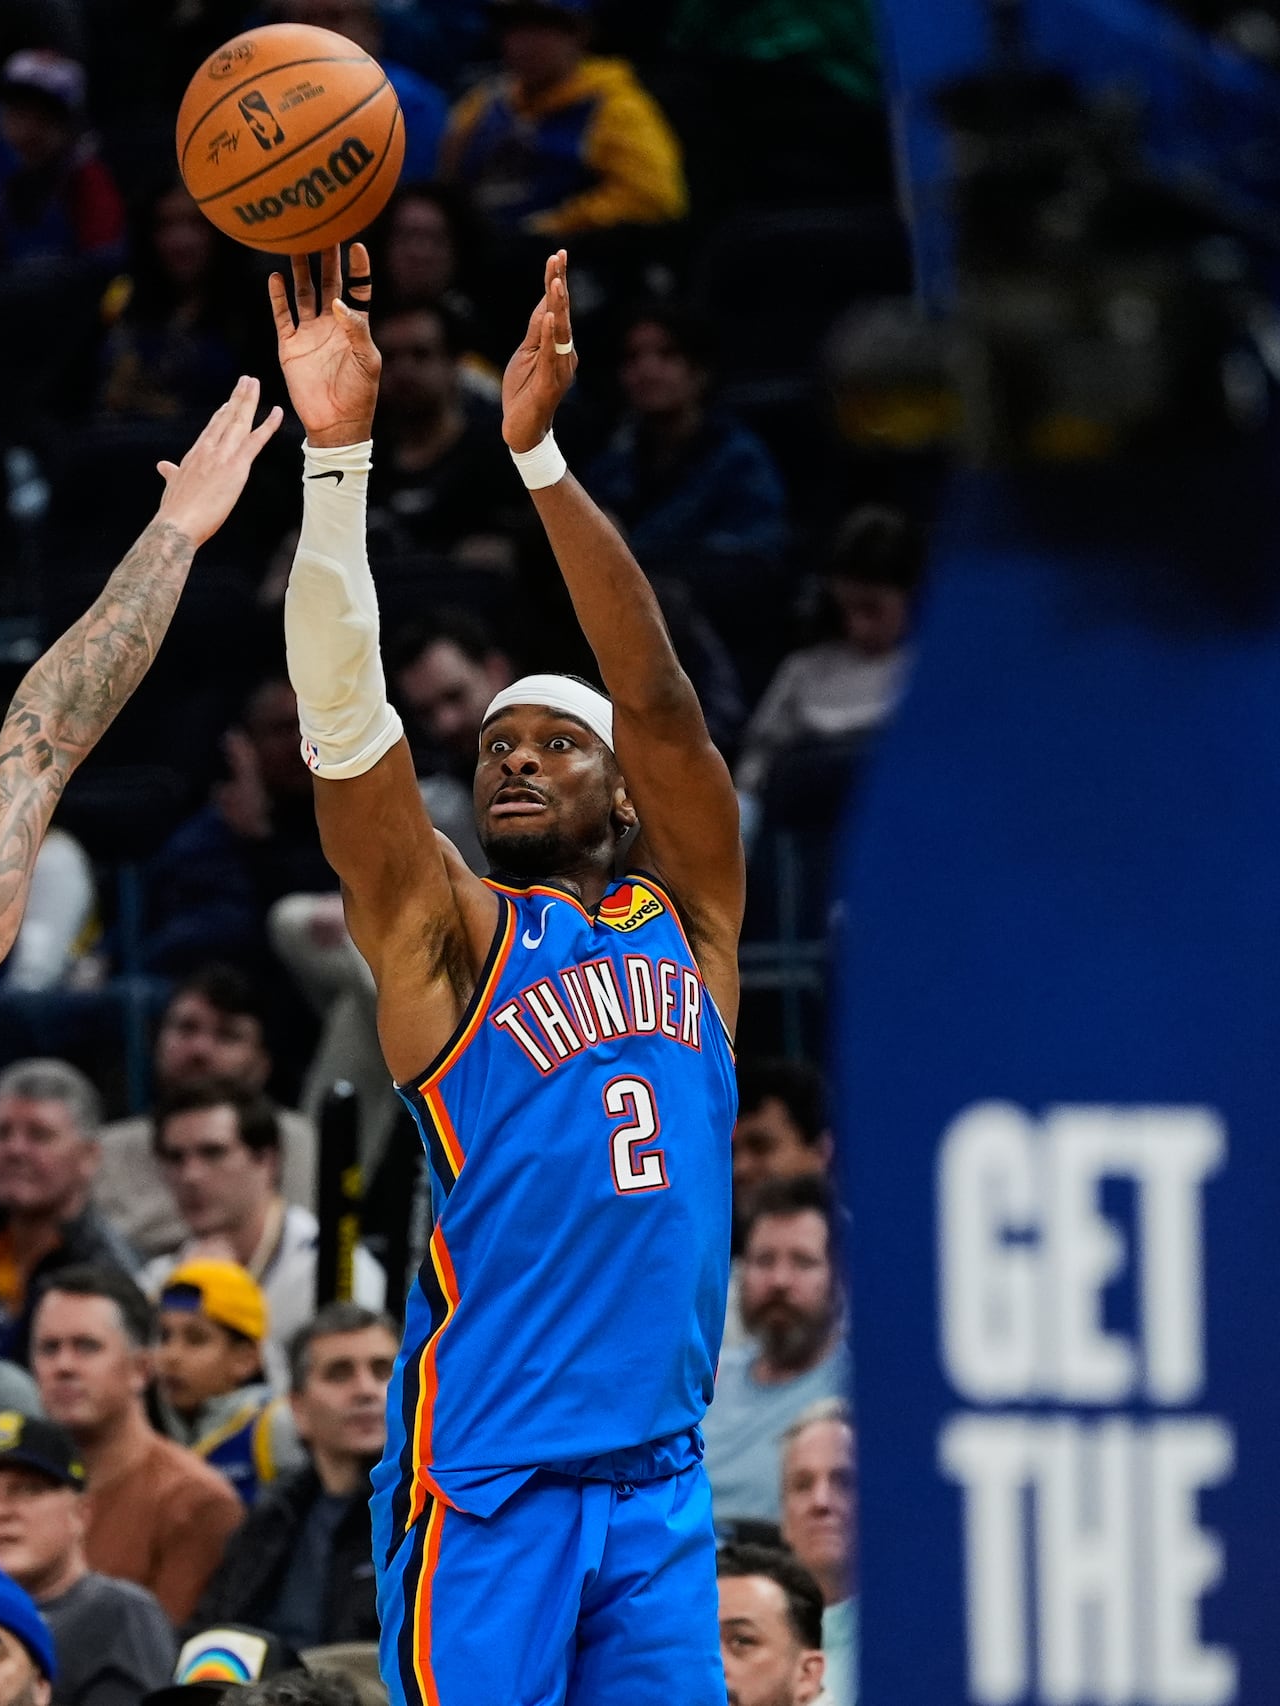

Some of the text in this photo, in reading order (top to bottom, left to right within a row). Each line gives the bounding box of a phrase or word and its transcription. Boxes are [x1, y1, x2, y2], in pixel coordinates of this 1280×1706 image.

[233, 137, 375, 225] Wilson
[489, 954, 702, 1077] THUNDER
[602, 1074, 669, 1196] 2
[937, 1103, 1228, 1406] GET
[937, 1412, 1238, 1704] THE
